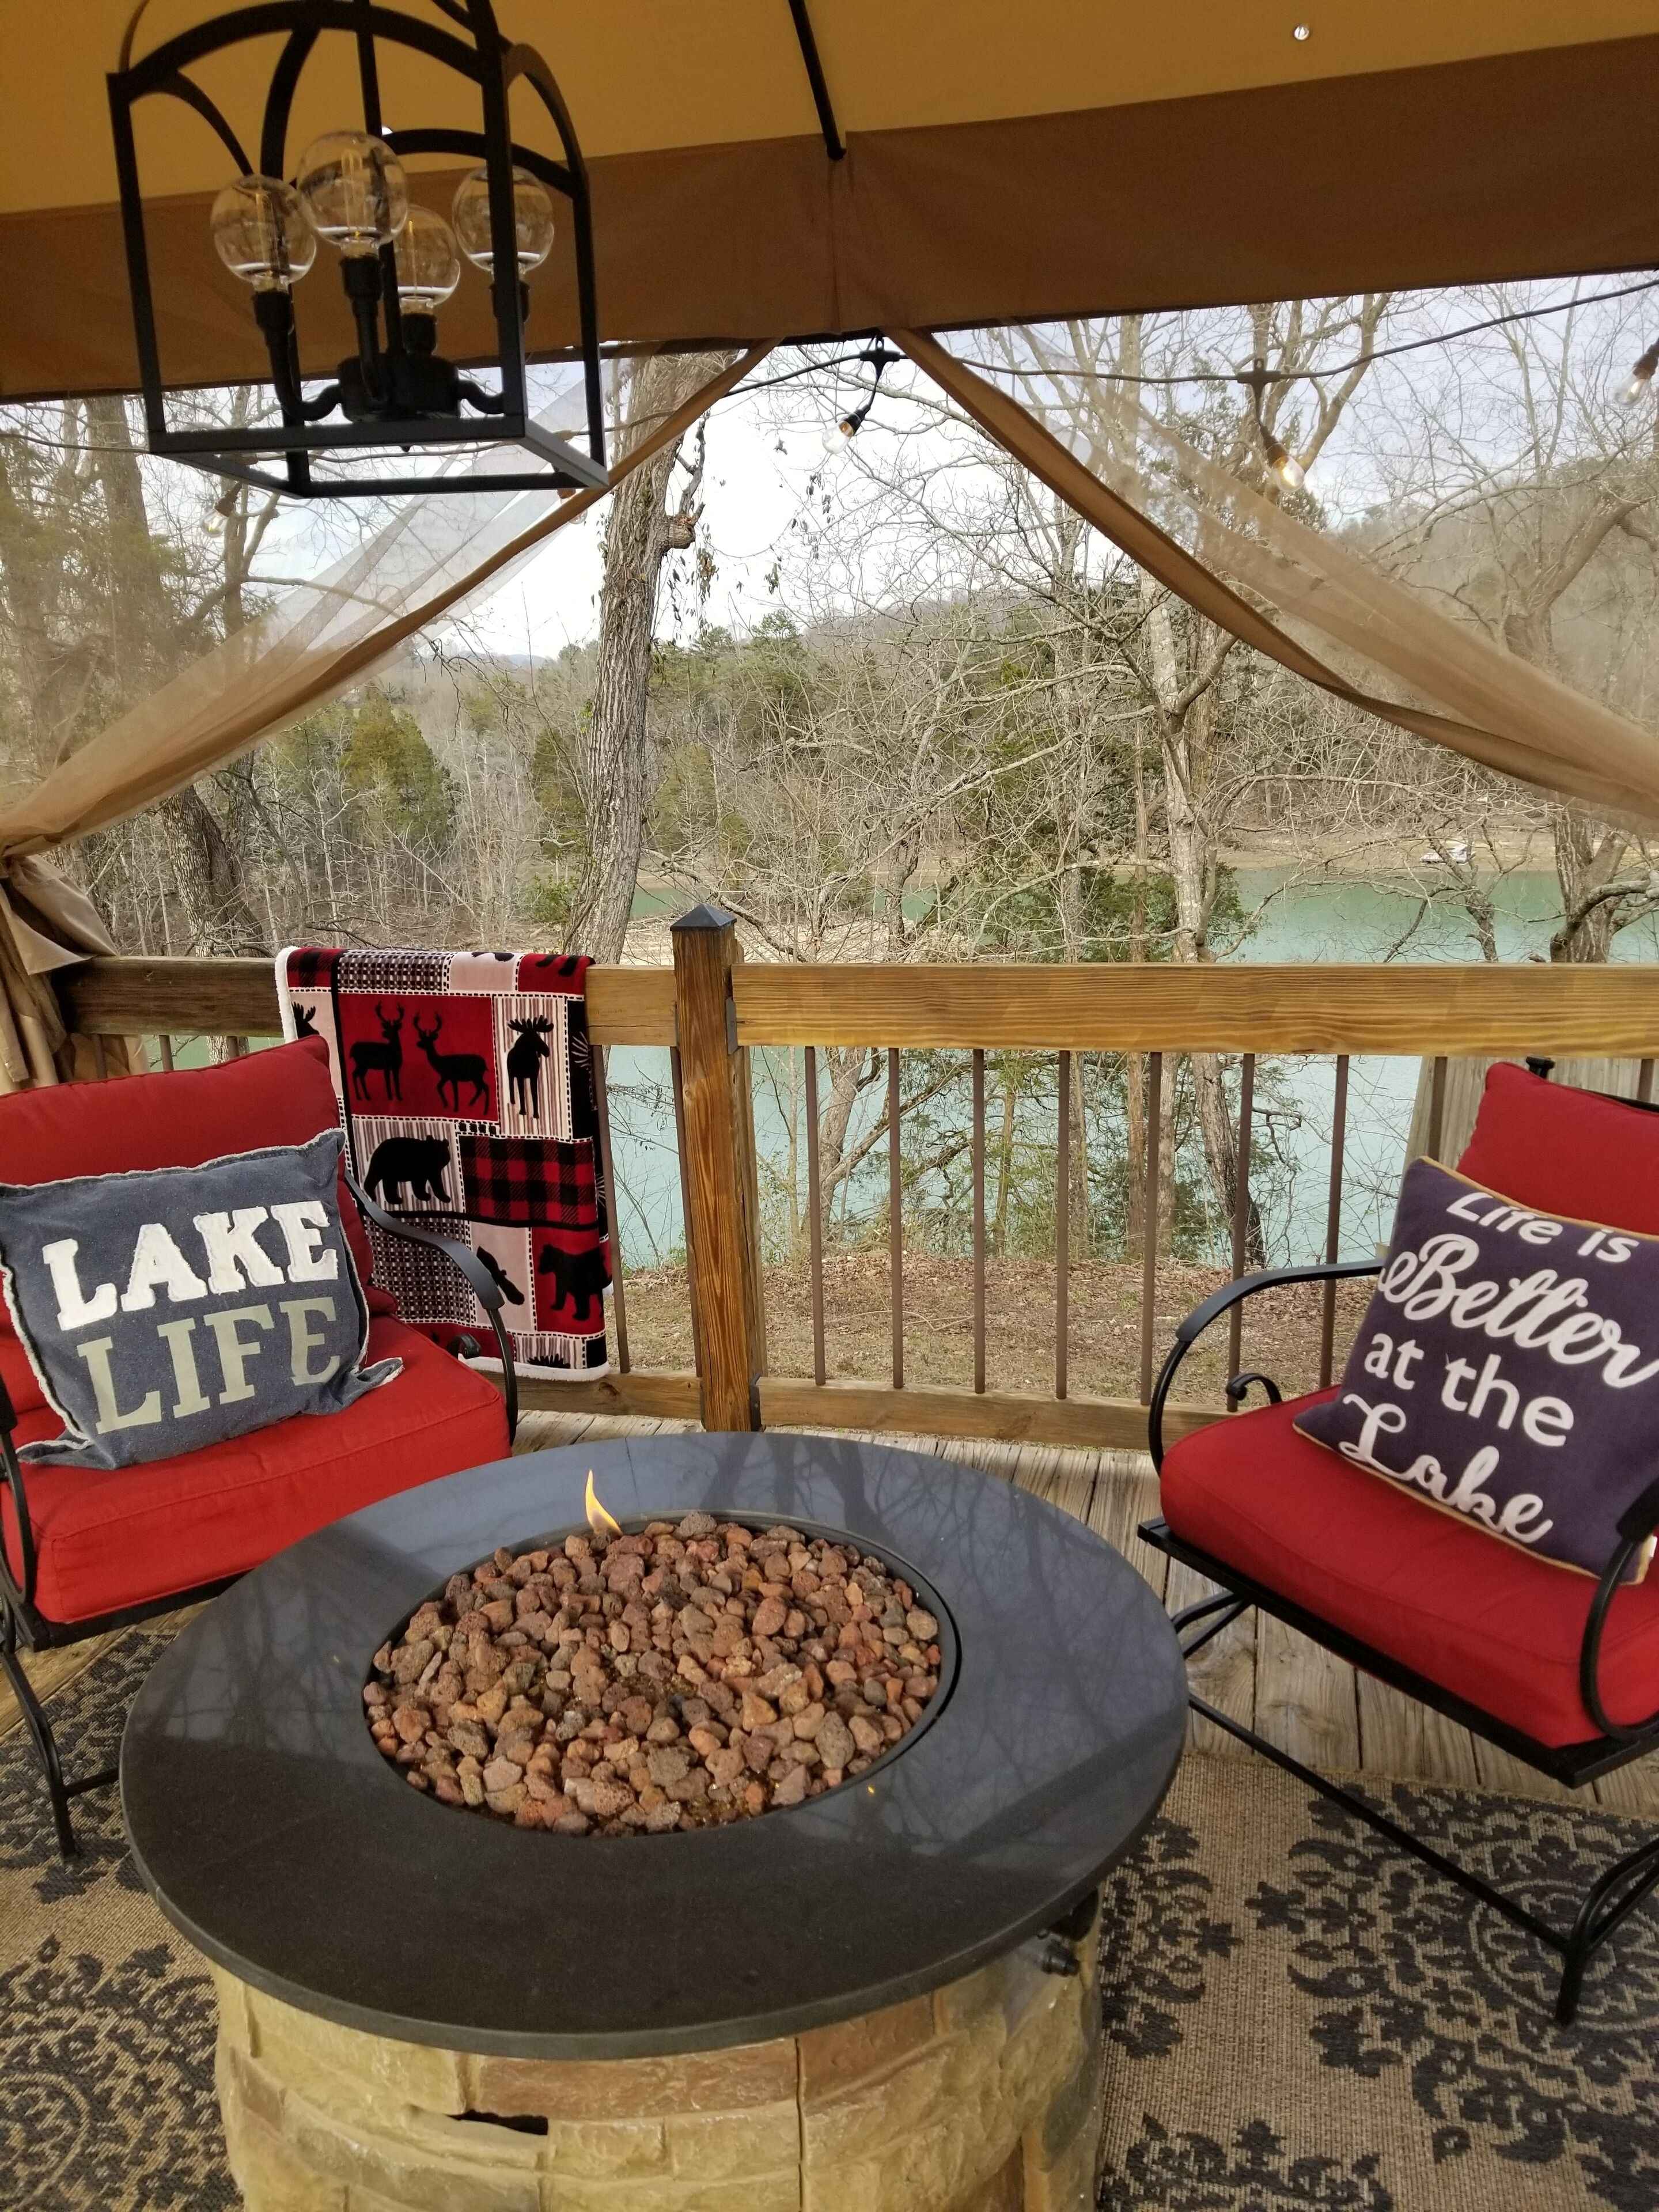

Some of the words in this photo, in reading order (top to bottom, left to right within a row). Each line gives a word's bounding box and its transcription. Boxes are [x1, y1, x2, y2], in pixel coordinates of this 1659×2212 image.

[43, 1200, 339, 1331] LAKE
[1446, 1192, 1563, 1245] Life
[1577, 1228, 1639, 1263] is
[77, 1297, 340, 1435] LIFE
[1378, 1233, 1659, 1389] Better
[1363, 1332, 1424, 1391] at
[1441, 1354, 1574, 1448] the
[1339, 1394, 1554, 1544] Lake
